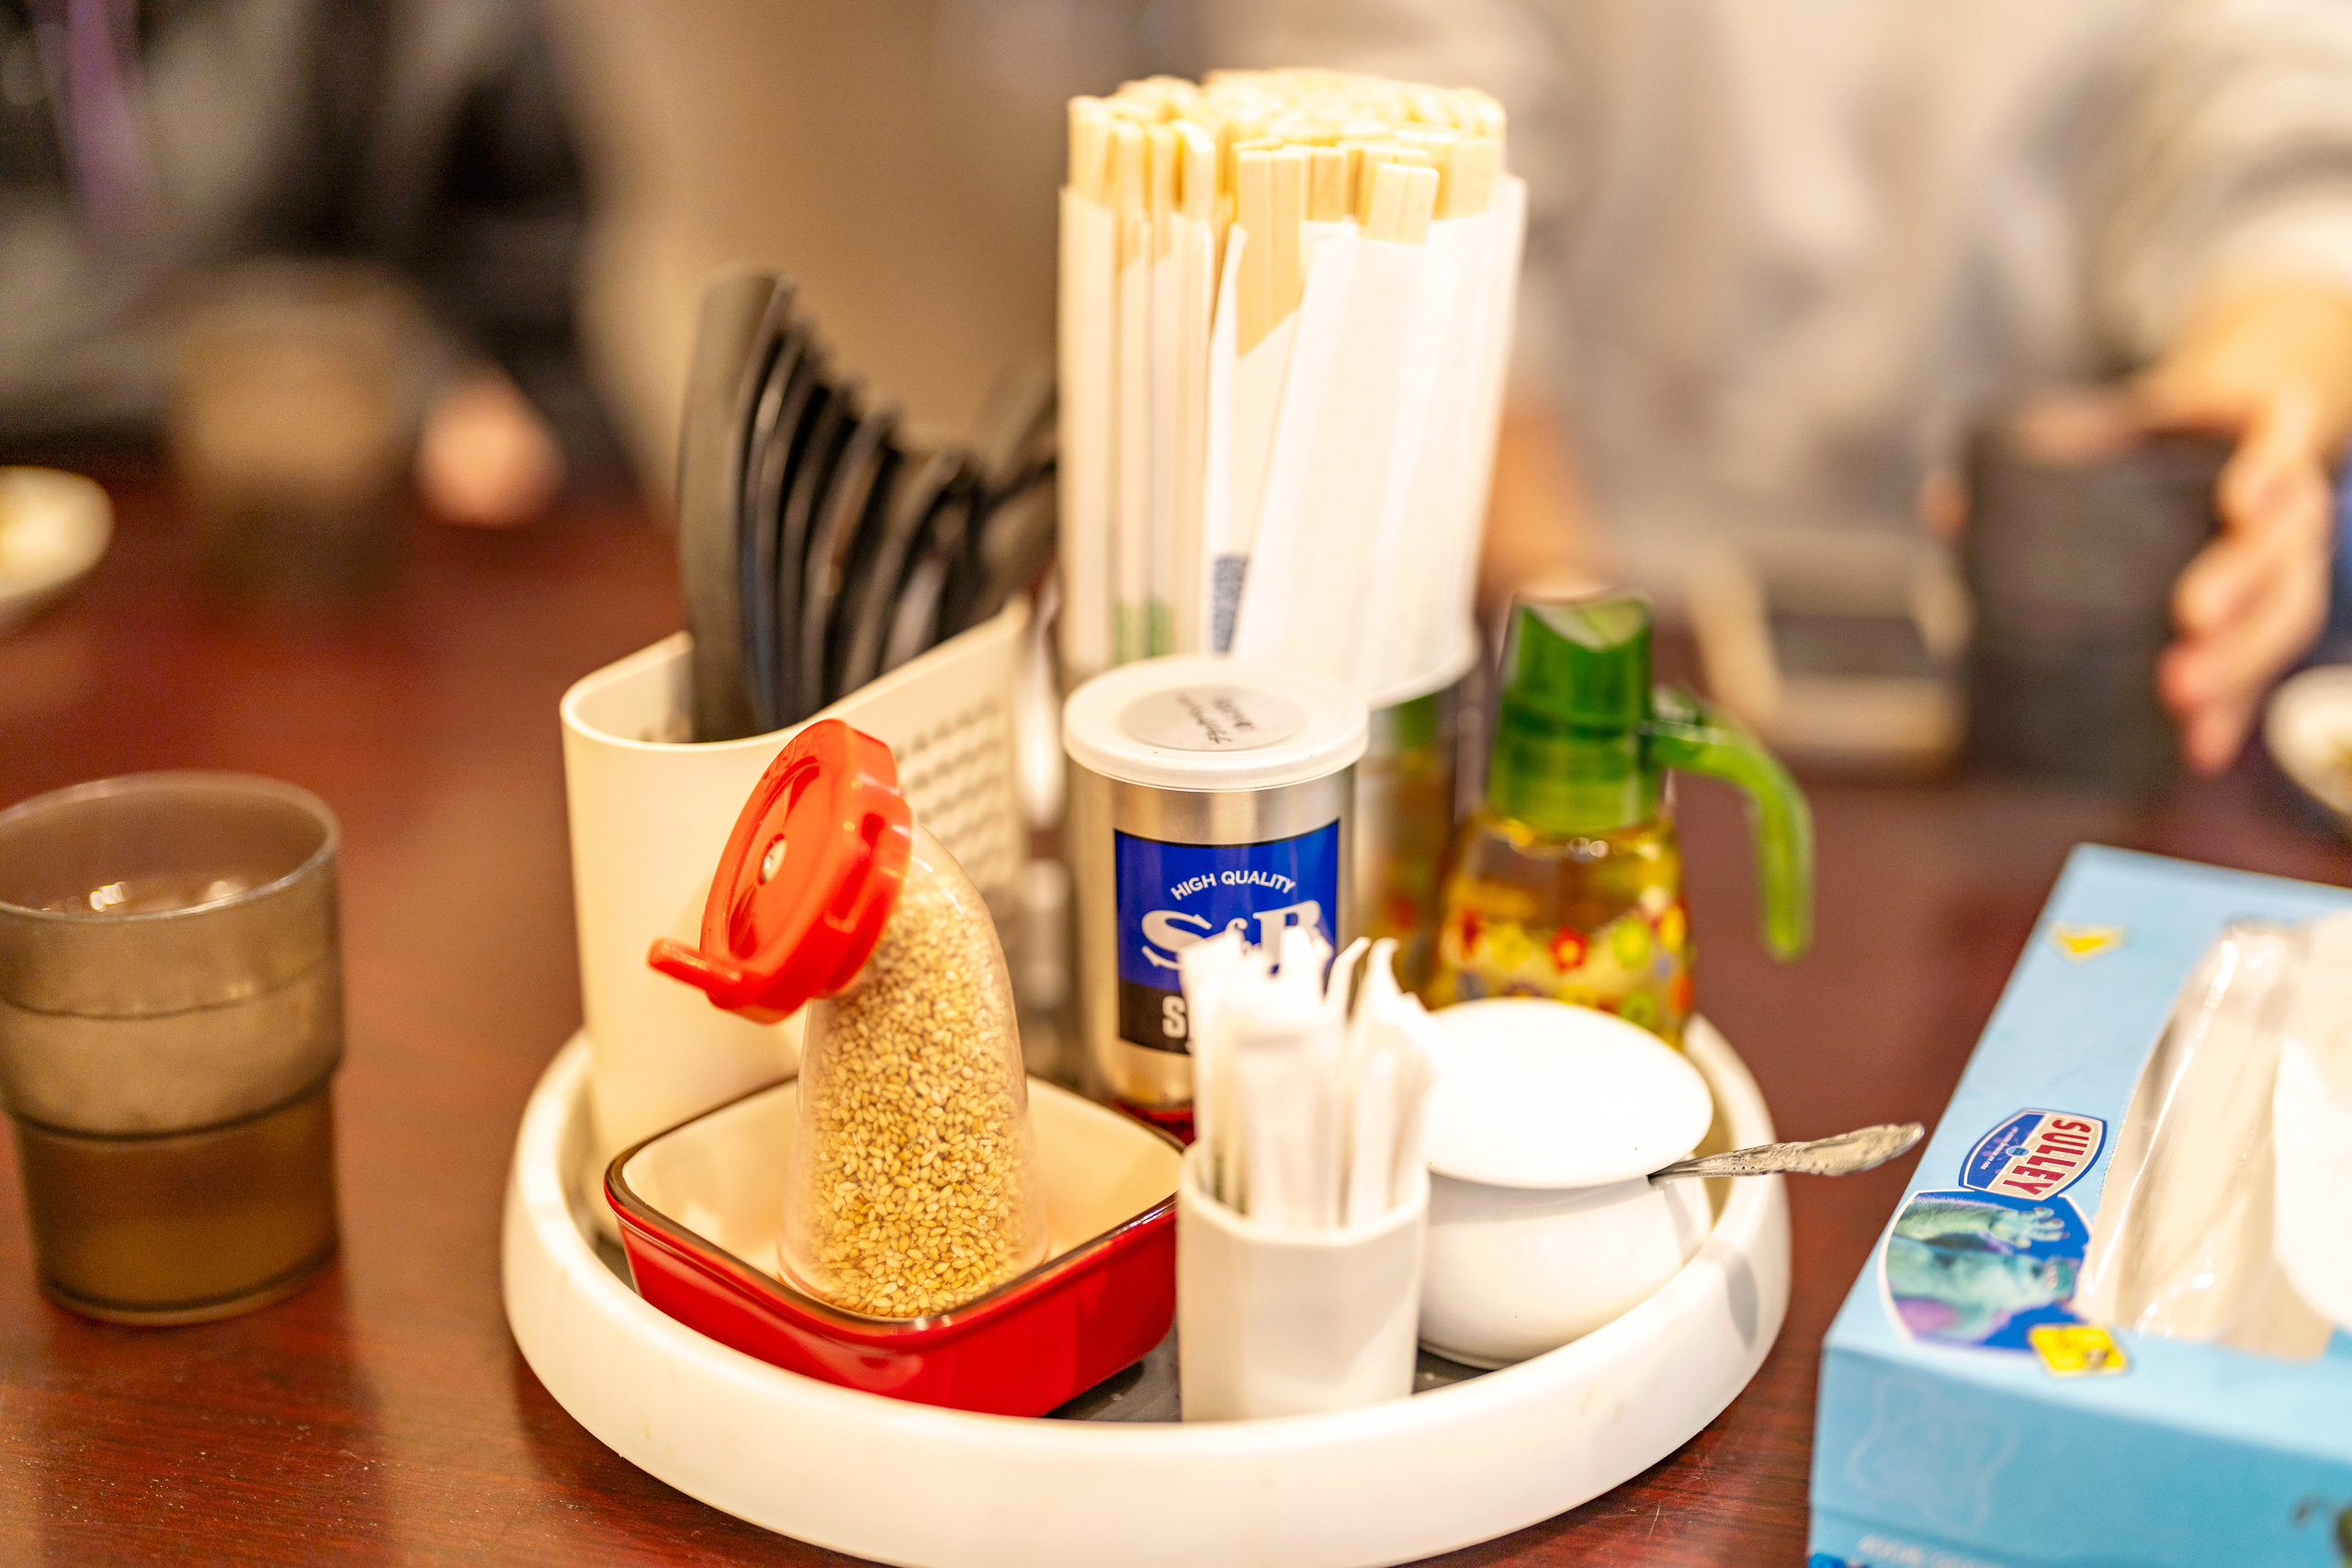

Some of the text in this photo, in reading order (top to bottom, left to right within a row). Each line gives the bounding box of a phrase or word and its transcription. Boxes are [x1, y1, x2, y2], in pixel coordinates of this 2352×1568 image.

[1170, 870, 1296, 900] HIGH QUALITY
[2002, 1119, 2092, 1196] SULLEY
